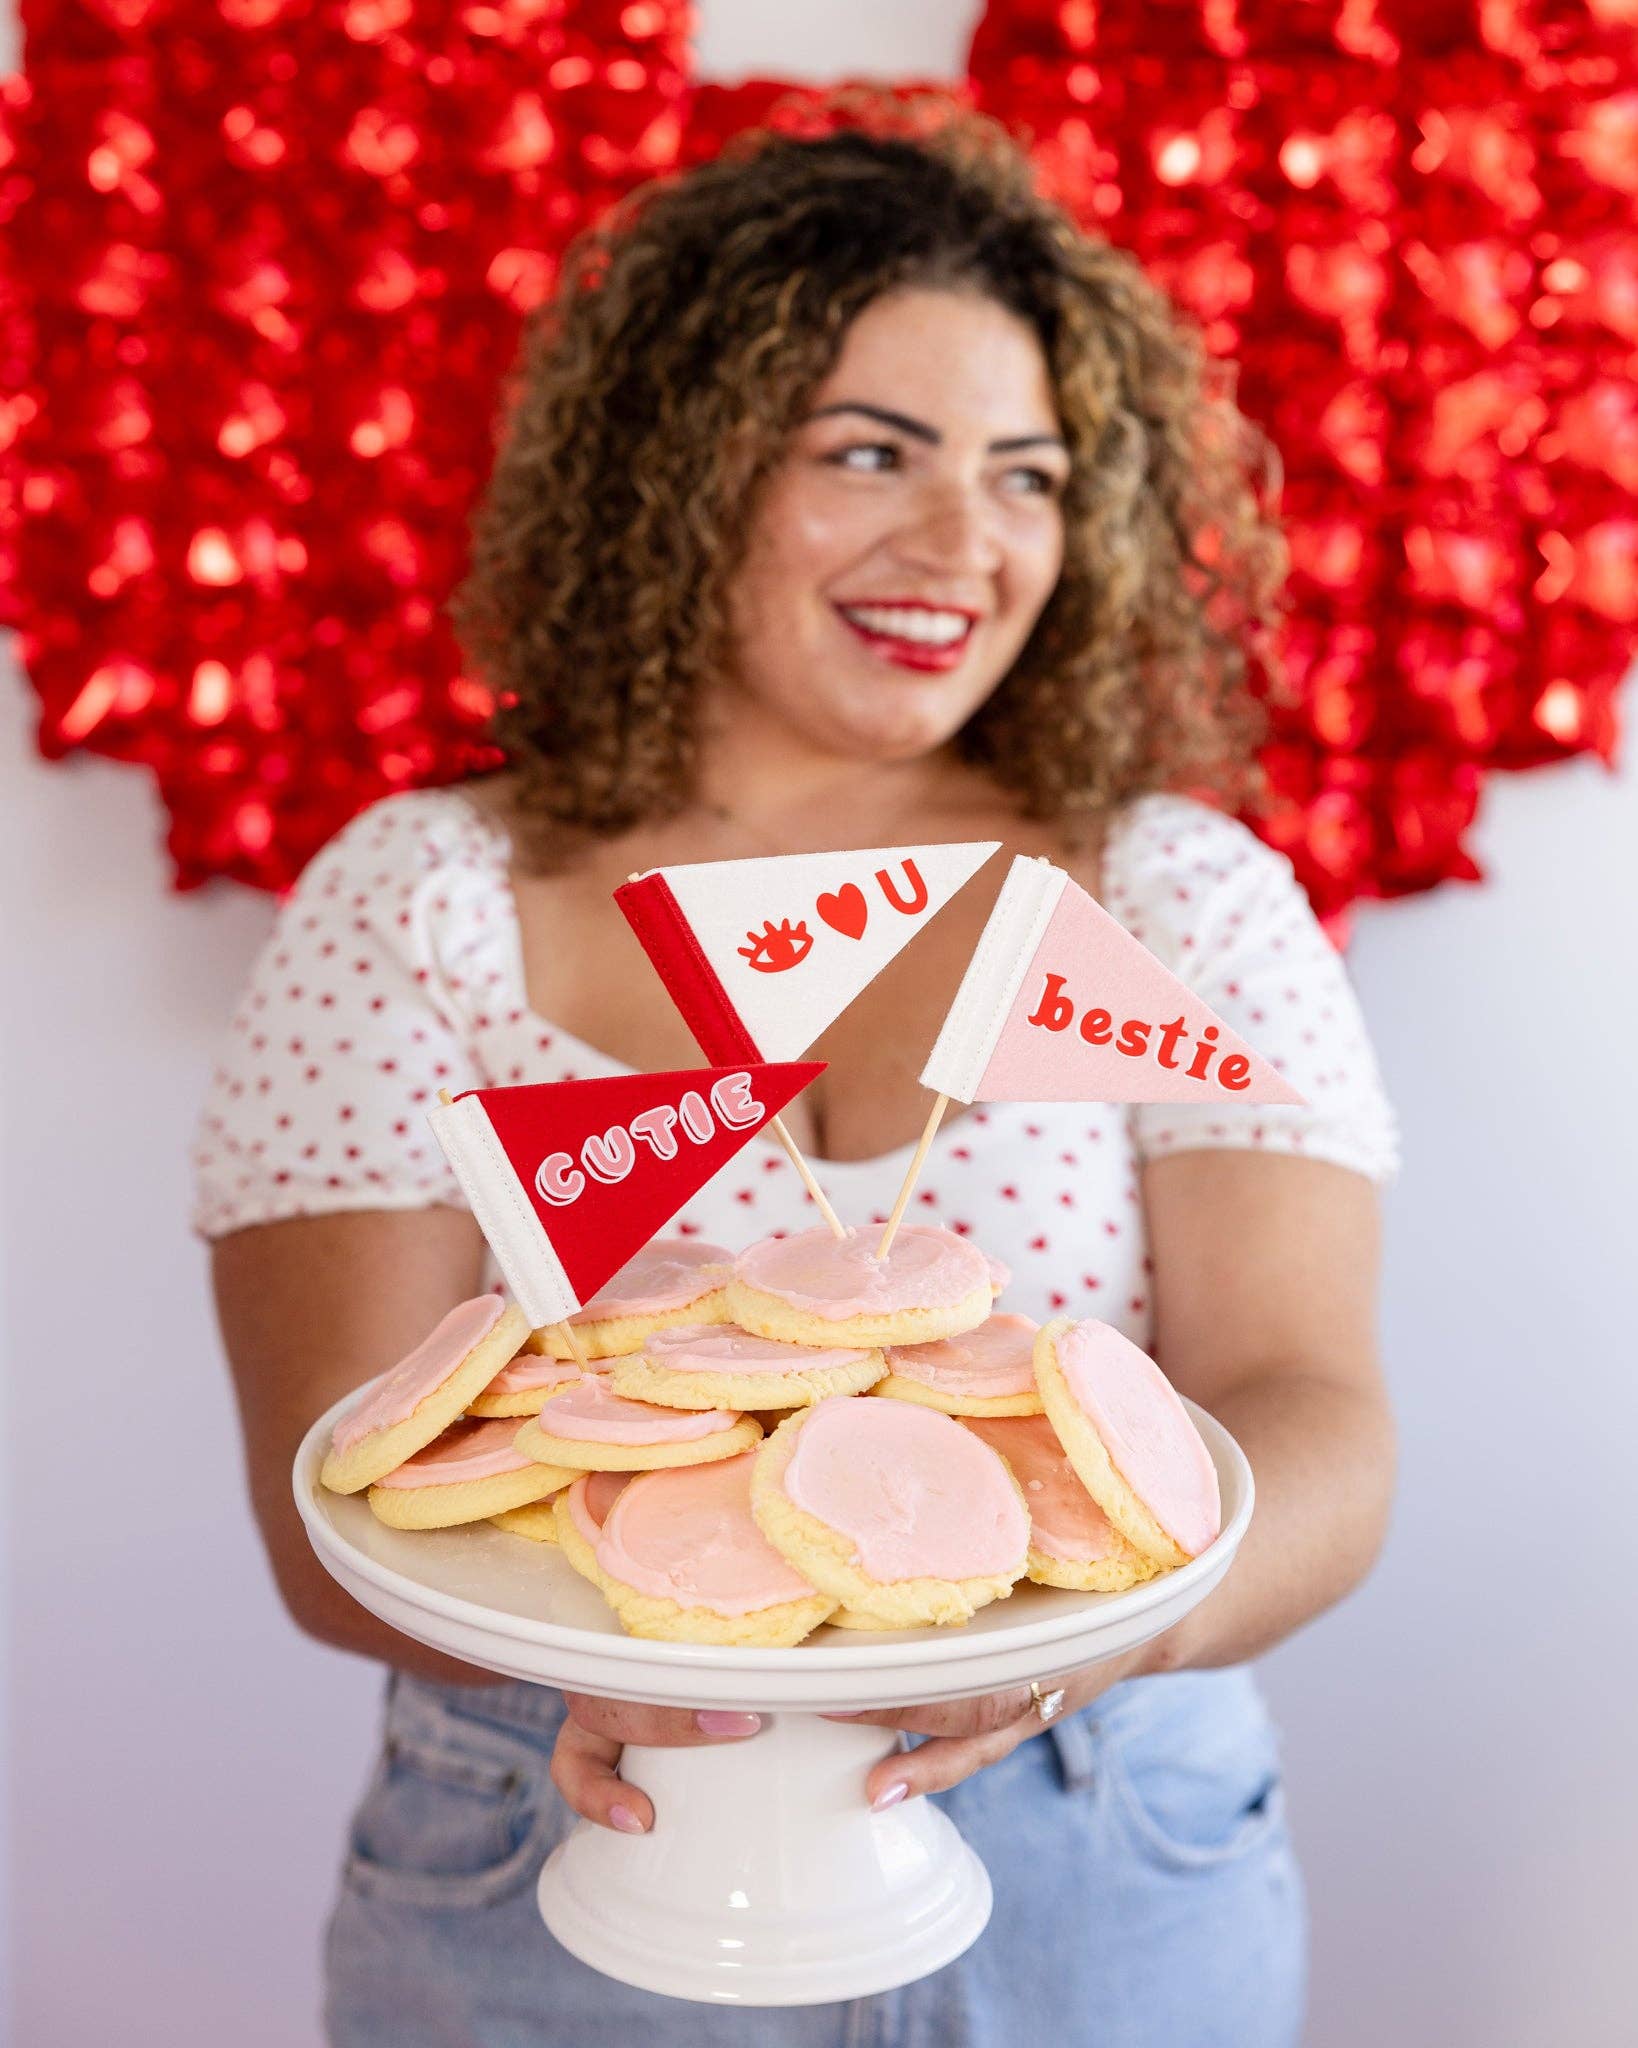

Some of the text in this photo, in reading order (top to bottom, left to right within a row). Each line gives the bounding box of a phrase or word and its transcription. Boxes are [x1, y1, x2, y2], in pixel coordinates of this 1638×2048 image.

[874, 858, 929, 916] U
[1027, 973, 1253, 1093] bestie
[535, 1071, 766, 1206] CUTIE
